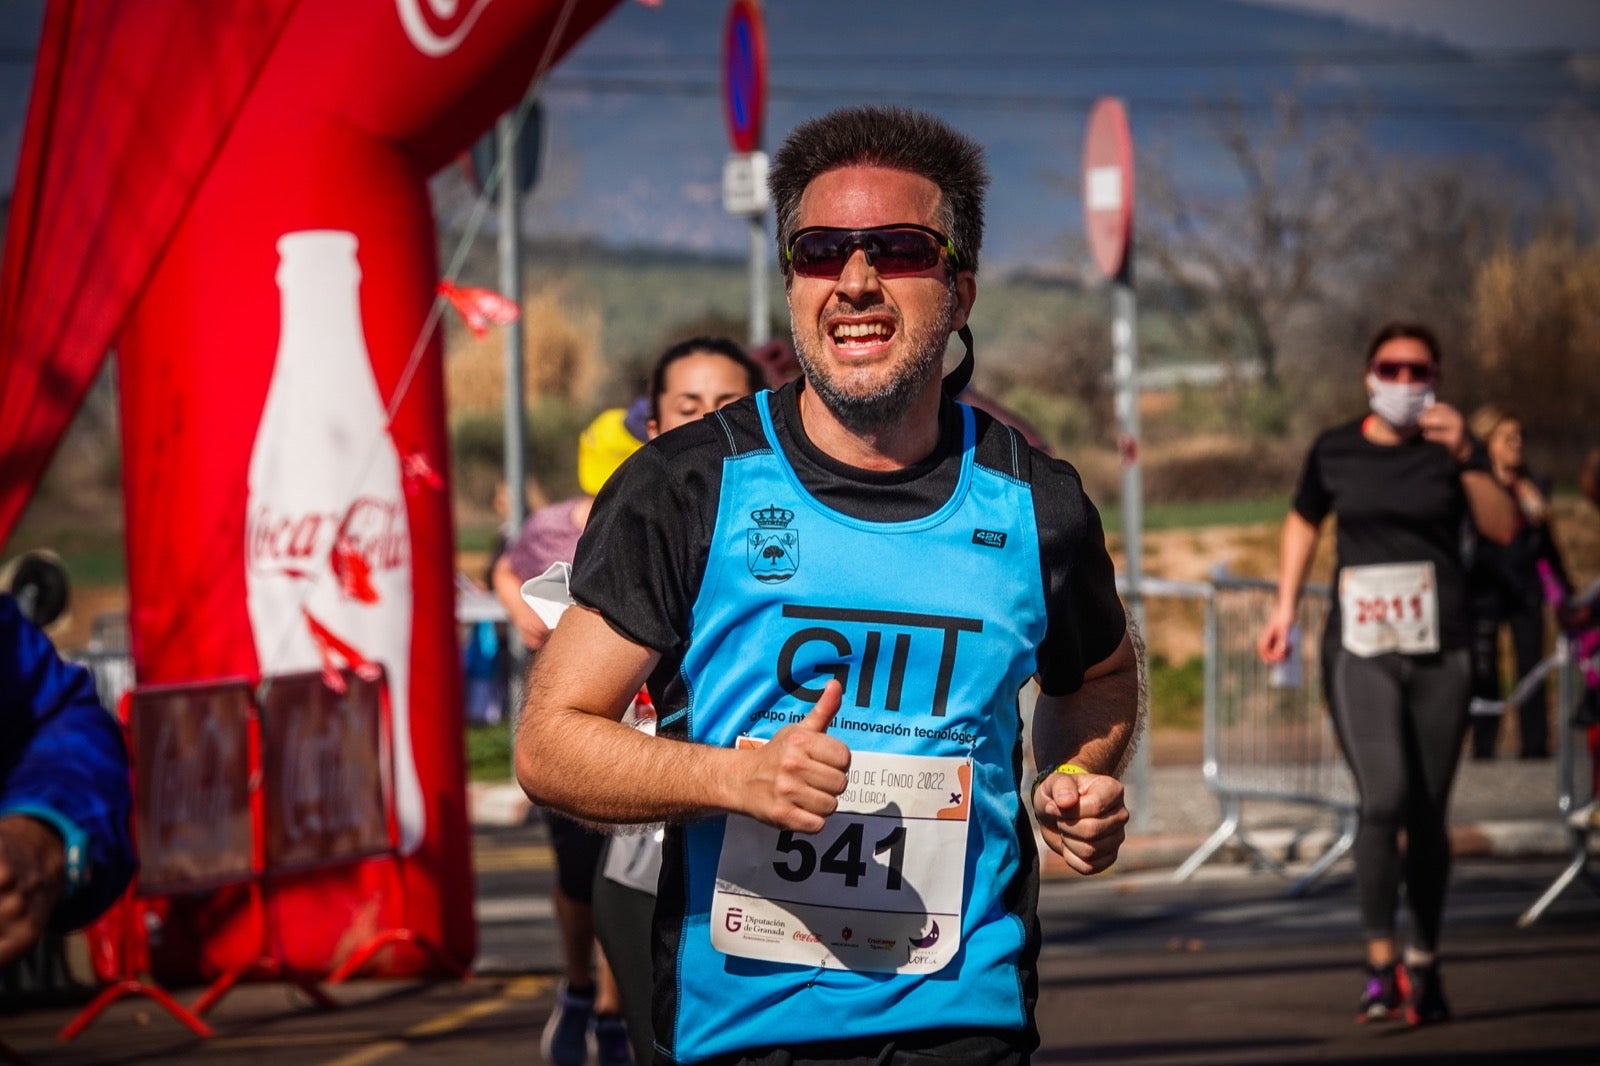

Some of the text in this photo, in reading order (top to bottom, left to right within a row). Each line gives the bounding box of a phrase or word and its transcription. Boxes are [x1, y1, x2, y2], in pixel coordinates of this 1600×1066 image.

[1355, 596, 1423, 625] 2011
[776, 604, 983, 717] GIIT
[750, 710, 977, 745] grupo intl innovación tecnológica
[917, 771, 945, 790] 2022
[773, 823, 907, 891] 541
[744, 924, 785, 936] de Granada
[745, 915, 786, 928] Diputación
